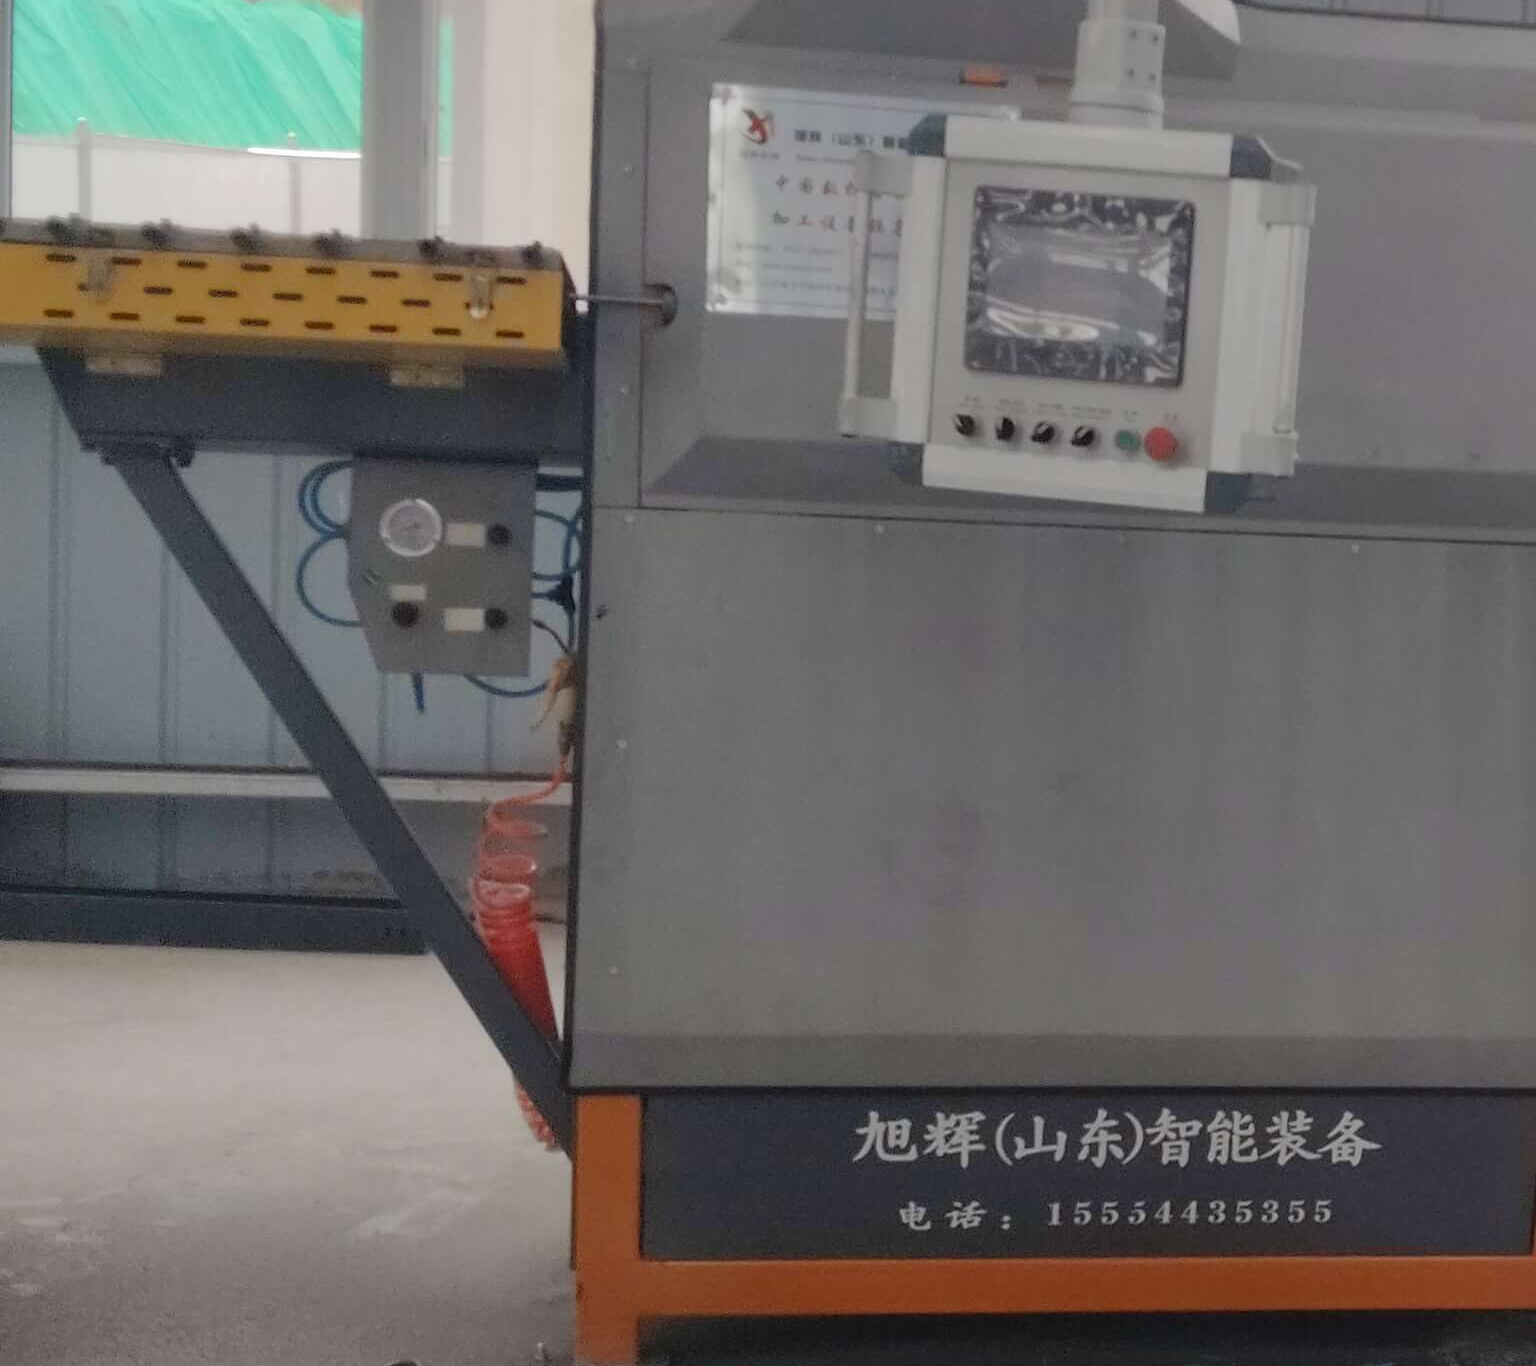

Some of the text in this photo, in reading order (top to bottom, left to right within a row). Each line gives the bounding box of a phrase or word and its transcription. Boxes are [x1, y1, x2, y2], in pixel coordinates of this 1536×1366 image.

[852, 1107, 1382, 1168] 旭辉(山东)智能装备
